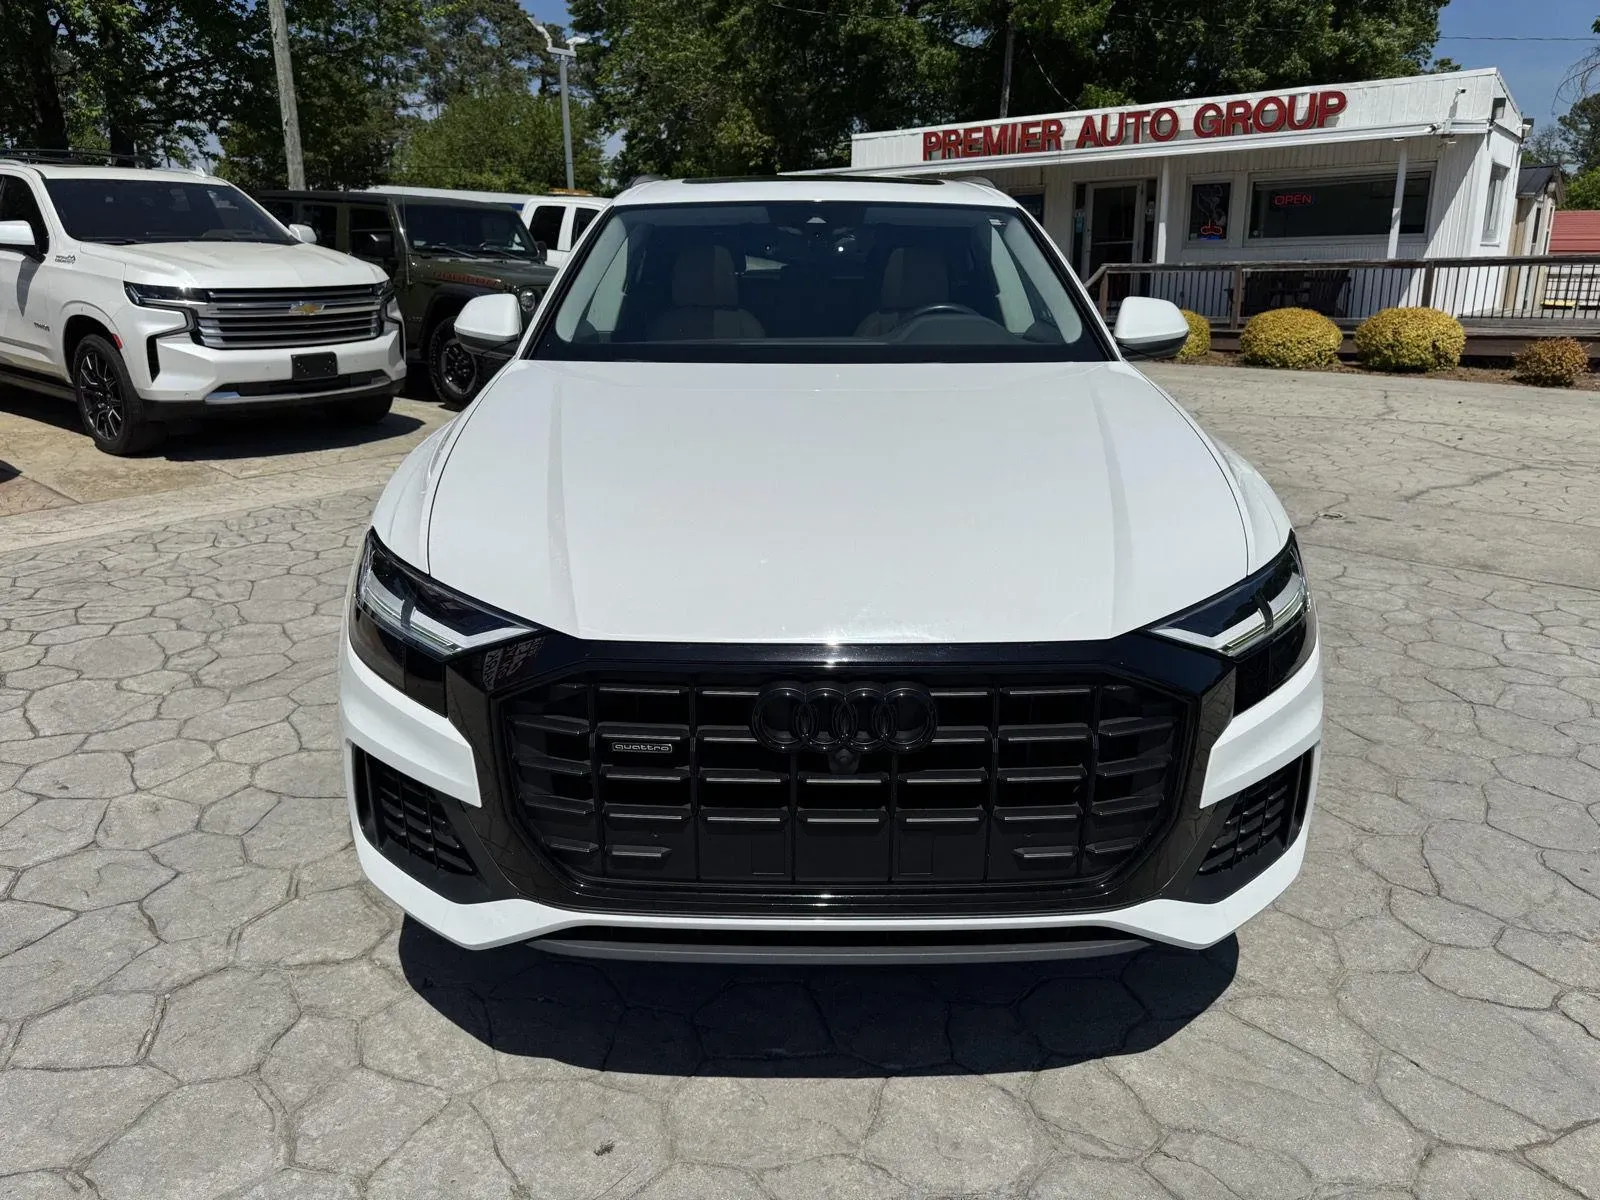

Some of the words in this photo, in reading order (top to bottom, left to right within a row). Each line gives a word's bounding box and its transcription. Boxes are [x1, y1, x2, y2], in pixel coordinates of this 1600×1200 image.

[923, 119, 1064, 161] PREMIER
[1075, 107, 1179, 148] AUTO
[1193, 90, 1347, 138] GROUP
[1273, 194, 1313, 206] OPEN
[614, 743, 670, 752] quattro
